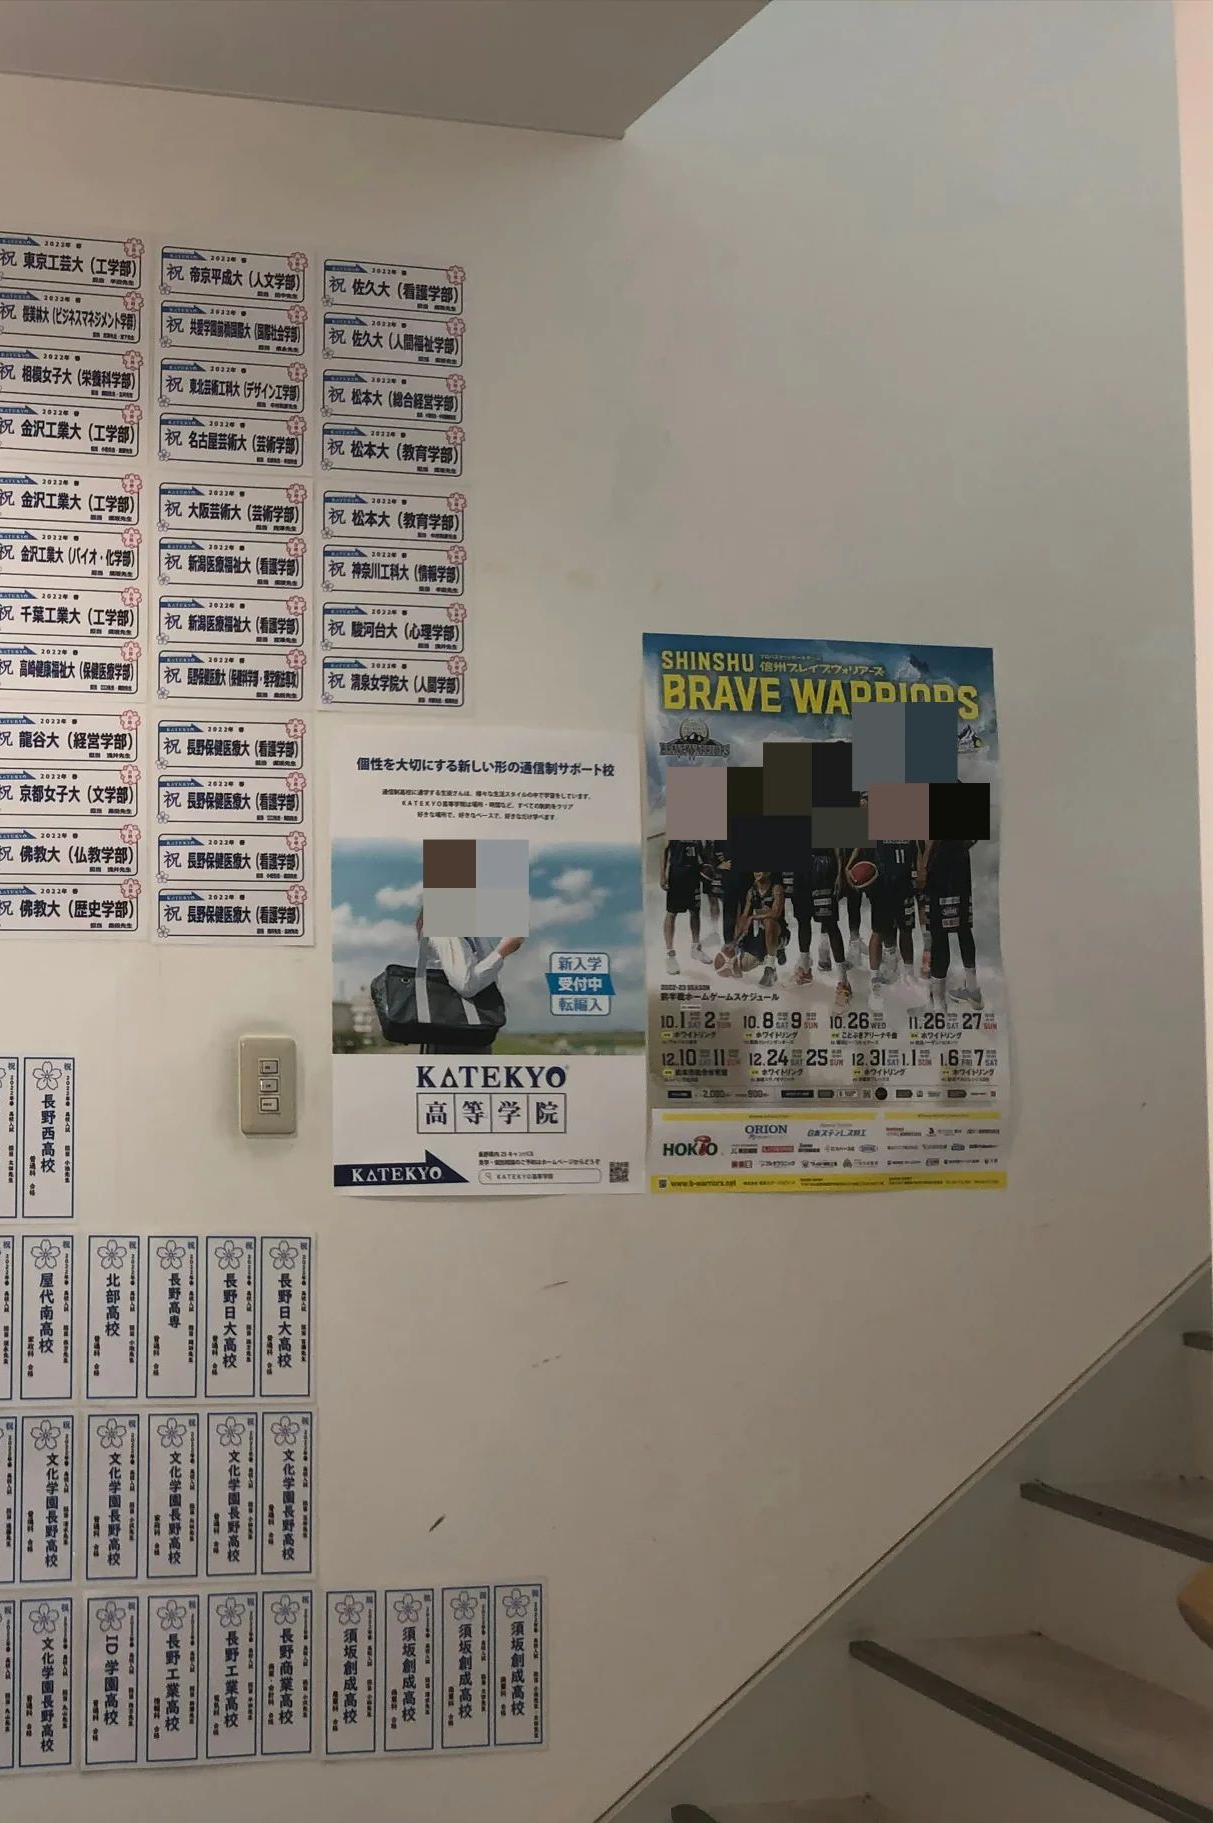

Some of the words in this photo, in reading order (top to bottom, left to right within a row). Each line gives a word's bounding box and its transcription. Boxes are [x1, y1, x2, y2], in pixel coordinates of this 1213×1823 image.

[24, 253, 136, 277] 東京工芸大（工学部）
[190, 266, 300, 291] 帝京平成大（人文学部）
[353, 279, 458, 304] 佐久大（看護学部）
[352, 332, 458, 356] 佐久大（人間福祉学部）
[22, 366, 134, 390] 相模女子大（栄養科学部）
[352, 388, 458, 412] 松本大（総合経営学部）
[21, 421, 134, 445] 金沢工業大（工学部）
[188, 431, 299, 455] 名古屋芸術大（芸術学部）
[351, 440, 457, 464] 松本大（教育学部）
[188, 501, 299, 524] 大阪芸術大（芸術学部）
[352, 562, 459, 584] 神奈川工科大（情報学部）
[20, 605, 134, 628] 千葉工業大（工学部）
[351, 619, 459, 642] 駿河台大（心理学部）
[661, 651, 753, 672] SHINSHU
[351, 672, 459, 696] 清泉女学院大（人間学部）
[662, 674, 782, 713] BRAVE
[19, 729, 133, 751] 龍谷大（経営学部）
[357, 757, 614, 777] 個性を大切にする新しい形の通信制サポート校
[20, 783, 133, 805] 京都女子大（文学部）
[20, 843, 133, 864] 佛教大（仏教学部）
[20, 898, 134, 919] 佛教大（歴史学部）
[558, 957, 602, 971] 新入学
[558, 977, 602, 992] 受付中
[558, 998, 602, 1012] 転編入
[416, 1066, 566, 1088] KATEKYO
[425, 1100, 558, 1125] 高等学院
[745, 1125, 787, 1134] ORION
[352, 1167, 442, 1181] KATEKYO
[105, 1273, 120, 1336] 北部高校
[168, 1273, 181, 1328] 長野高専
[223, 1273, 237, 1368] 長野日大高校
[227, 1449, 241, 1563] 文化学園長野高校
[165, 1634, 181, 1731] 長野工業高校
[279, 1628, 293, 1725] 長野商業高校
[343, 1628, 358, 1723] 須坂創成高校
